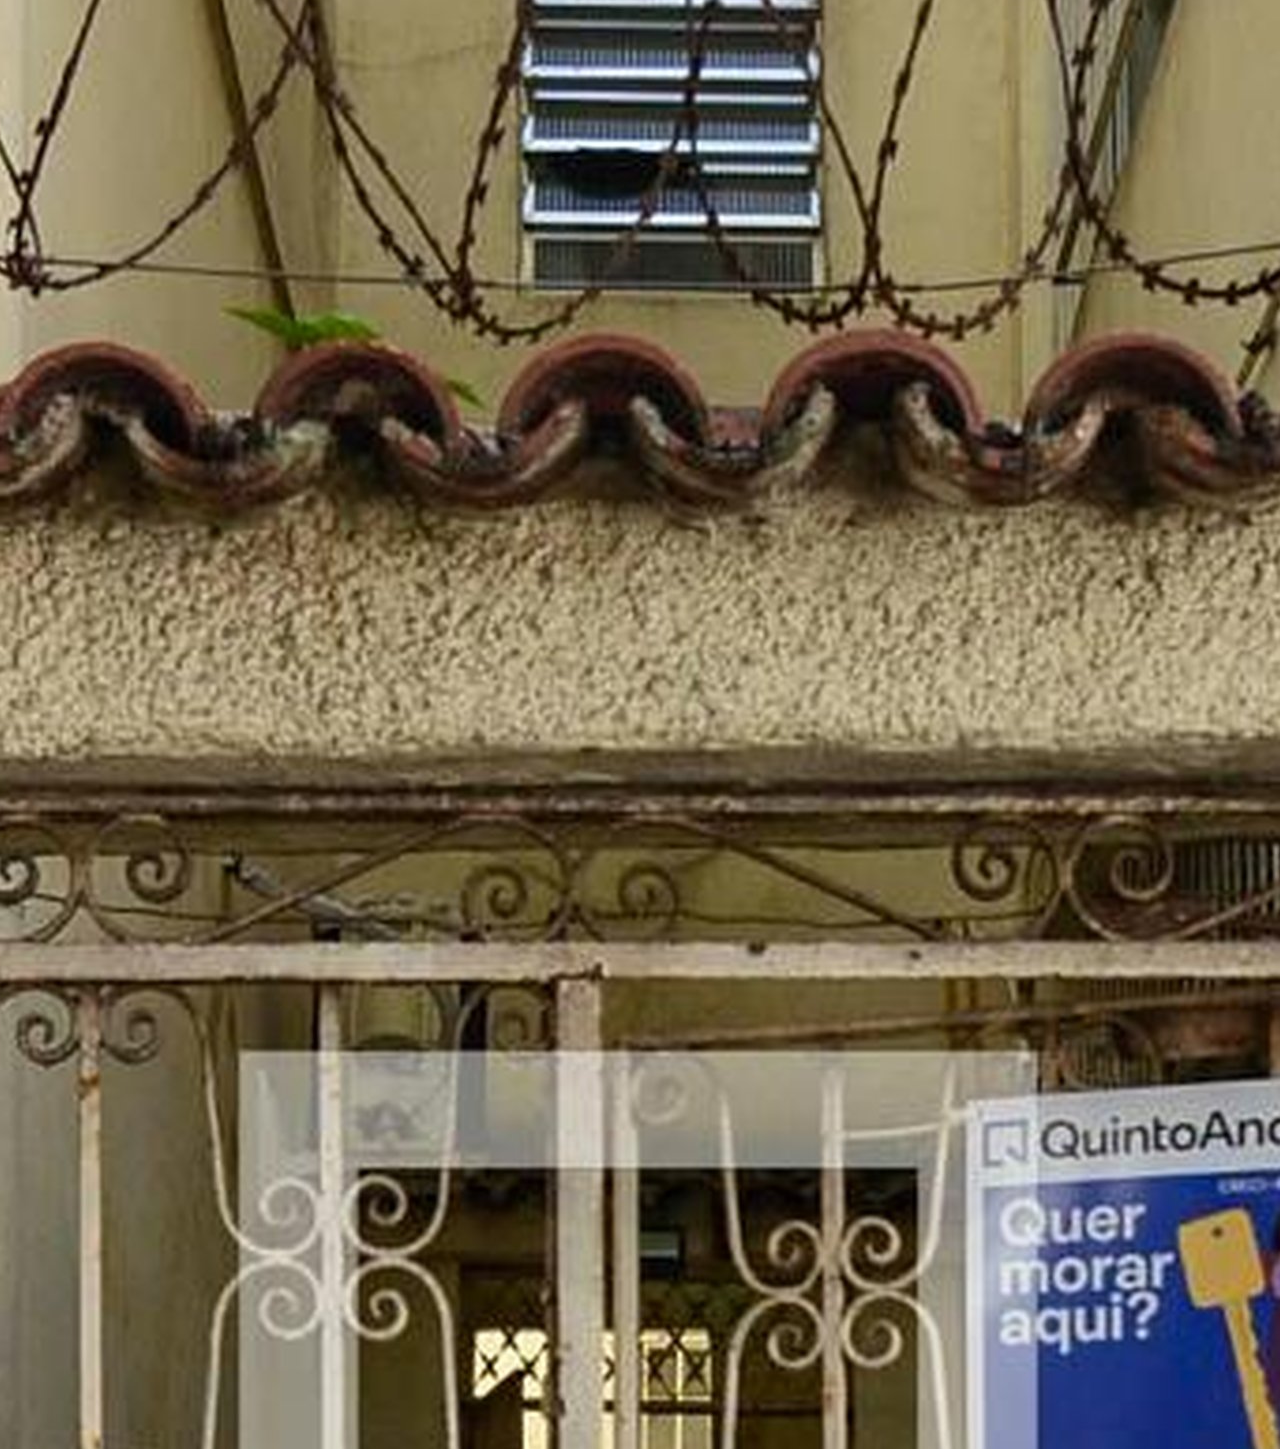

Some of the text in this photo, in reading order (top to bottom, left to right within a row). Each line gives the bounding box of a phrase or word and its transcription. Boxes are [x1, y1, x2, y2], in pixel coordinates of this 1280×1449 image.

[999, 1198, 1147, 1247] Quer
[999, 1252, 1175, 1295] morar
[999, 1291, 1160, 1355] aqui?
